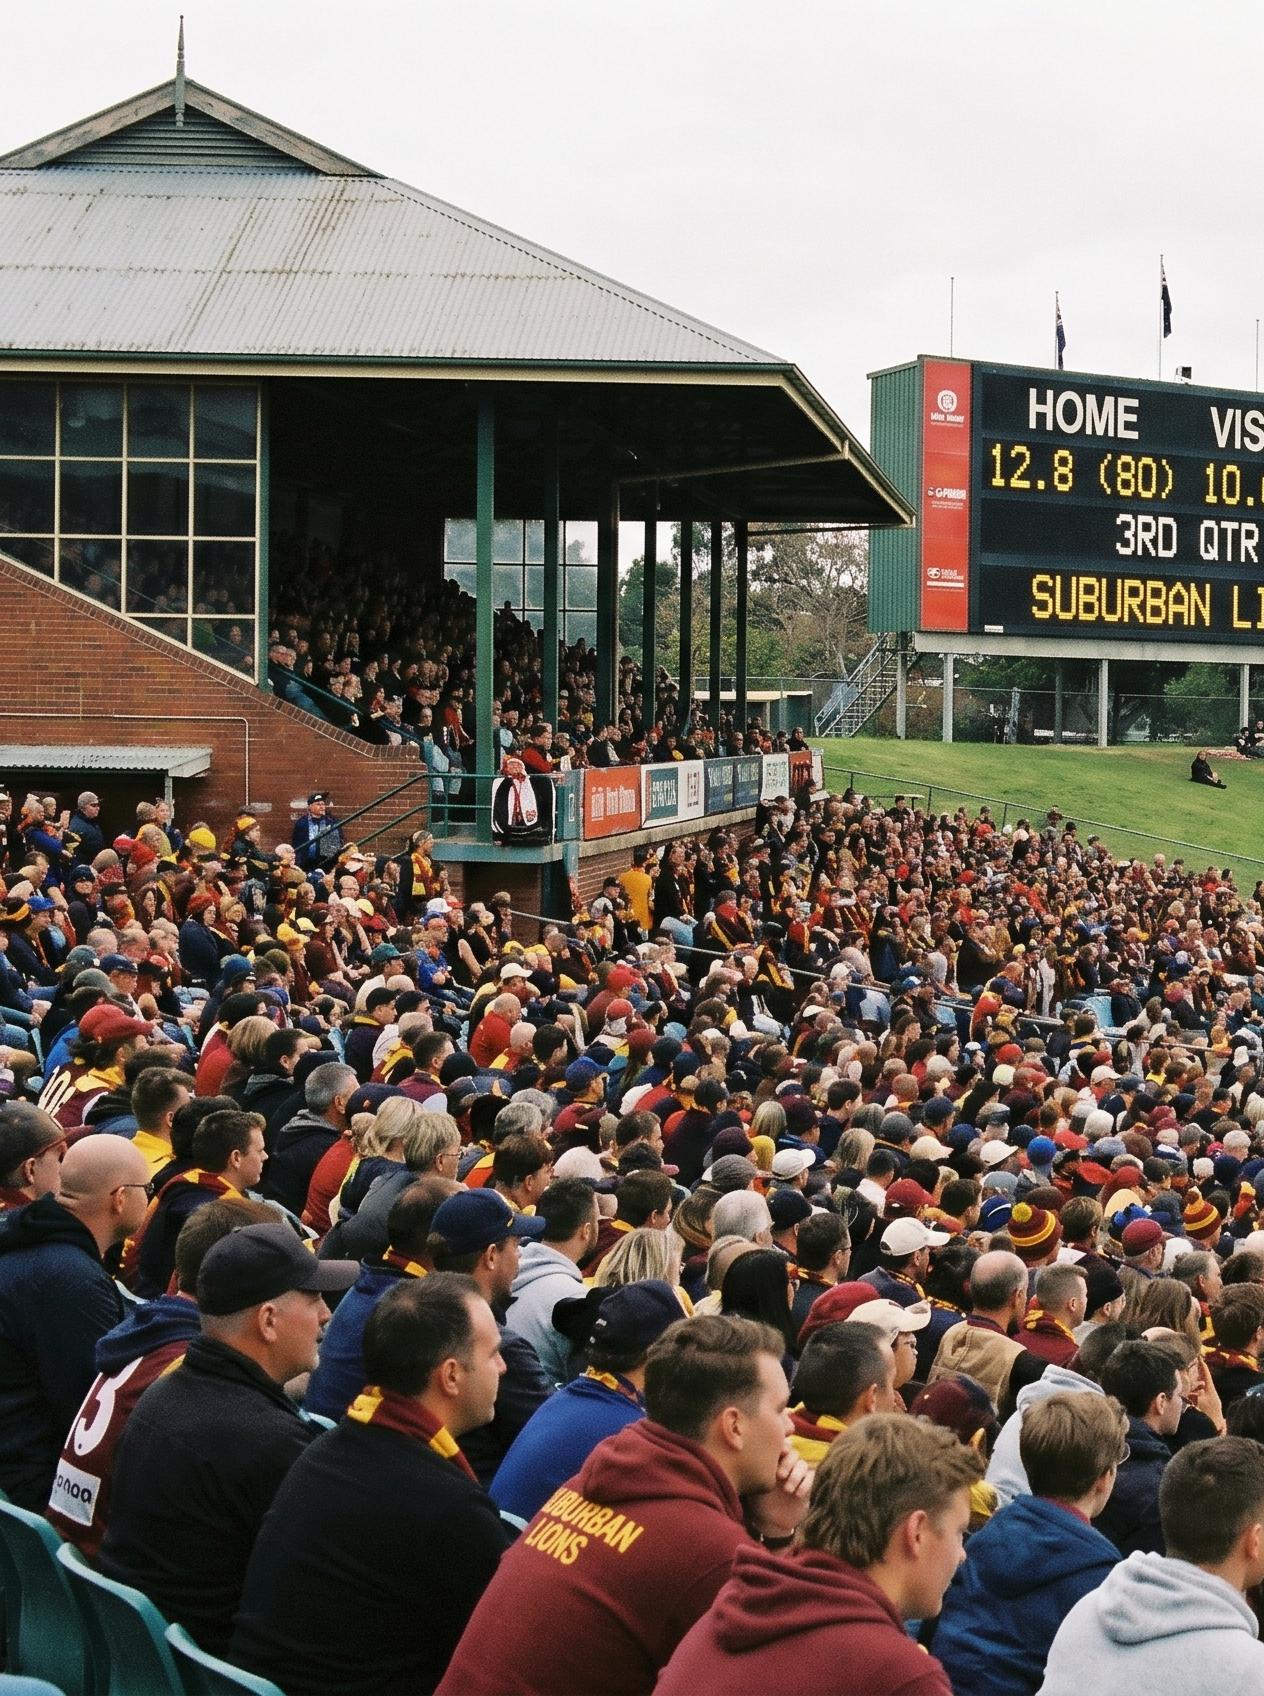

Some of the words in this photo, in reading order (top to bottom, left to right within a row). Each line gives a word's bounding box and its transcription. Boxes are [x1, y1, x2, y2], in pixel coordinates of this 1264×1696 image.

[1028, 387, 1140, 440] HOME
[991, 443, 1073, 492] 12.8
[1099, 453, 1173, 500] (80)
[1115, 513, 1178, 558] 3RD
[1199, 519, 1260, 564] QTR
[1031, 573, 1211, 627] SUBURBAN
[524, 1517, 589, 1565] LIONS
